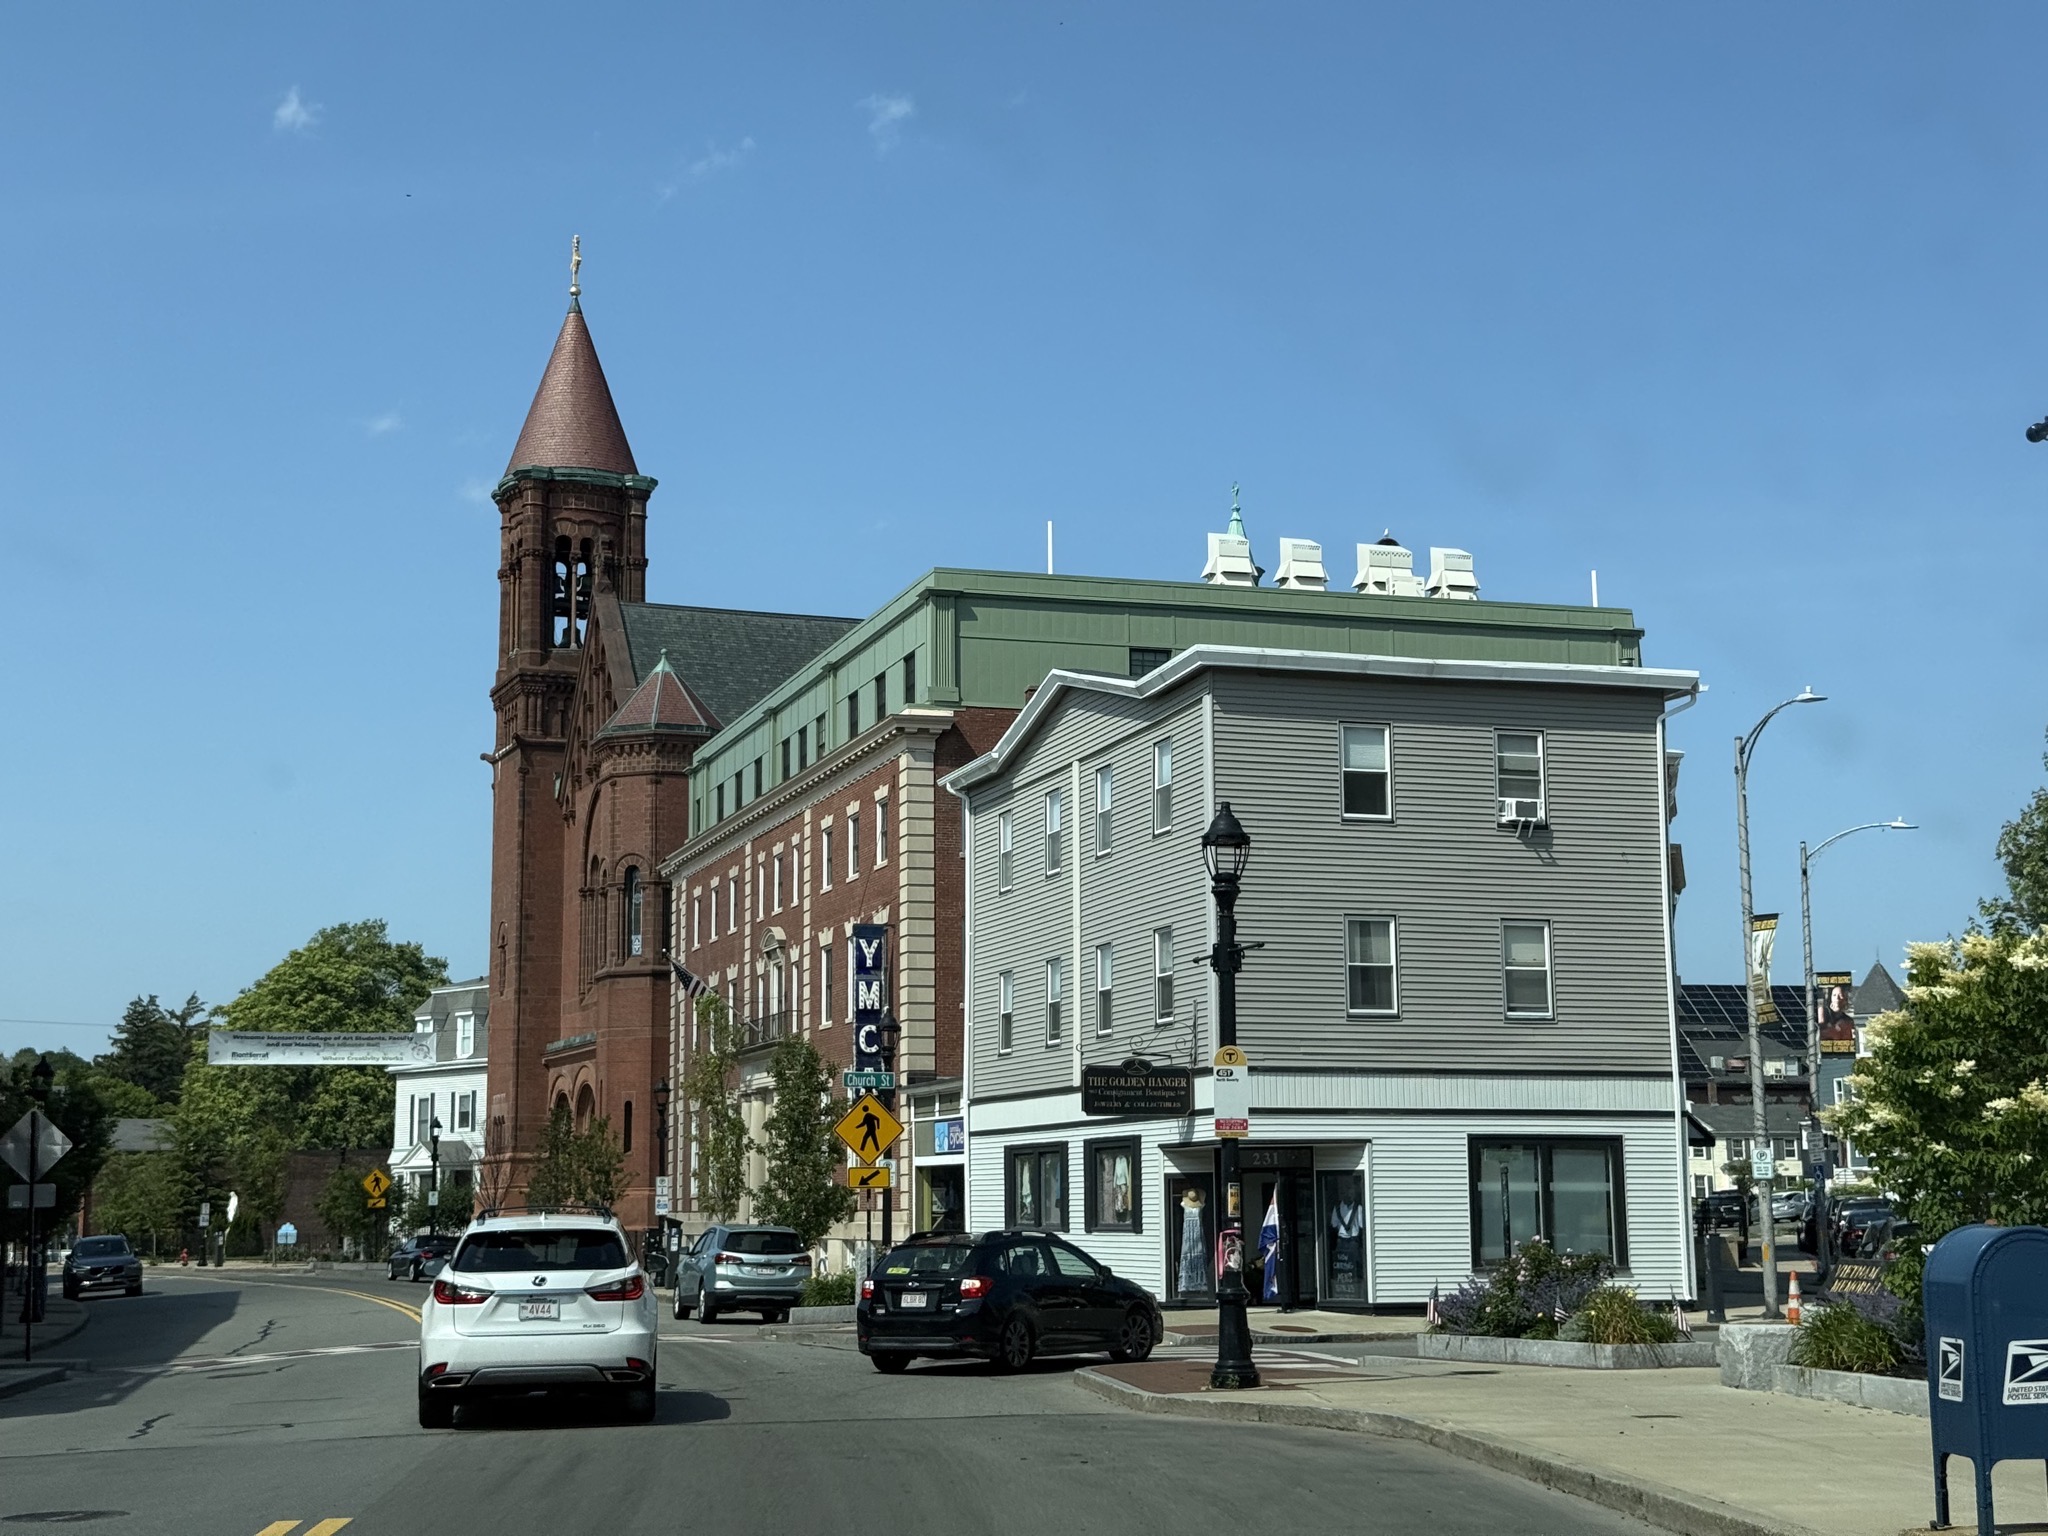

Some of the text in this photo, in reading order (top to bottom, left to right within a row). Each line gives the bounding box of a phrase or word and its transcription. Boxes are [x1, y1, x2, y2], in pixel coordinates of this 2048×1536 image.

[847, 1074, 890, 1087] Church St
[1088, 1076, 1187, 1087] THE GOLDEN HANGER
[1098, 1088, 1176, 1098] Consignment Boutique
[1253, 1153, 1279, 1165] 231
[1835, 1264, 1881, 1279] VIETNAM
[1830, 1279, 1882, 1295] MEMORIAL
[529, 1304, 551, 1315] 4V44
[2007, 1386, 2034, 1394] UNITED
[2007, 1393, 2032, 1401] POSTAL
